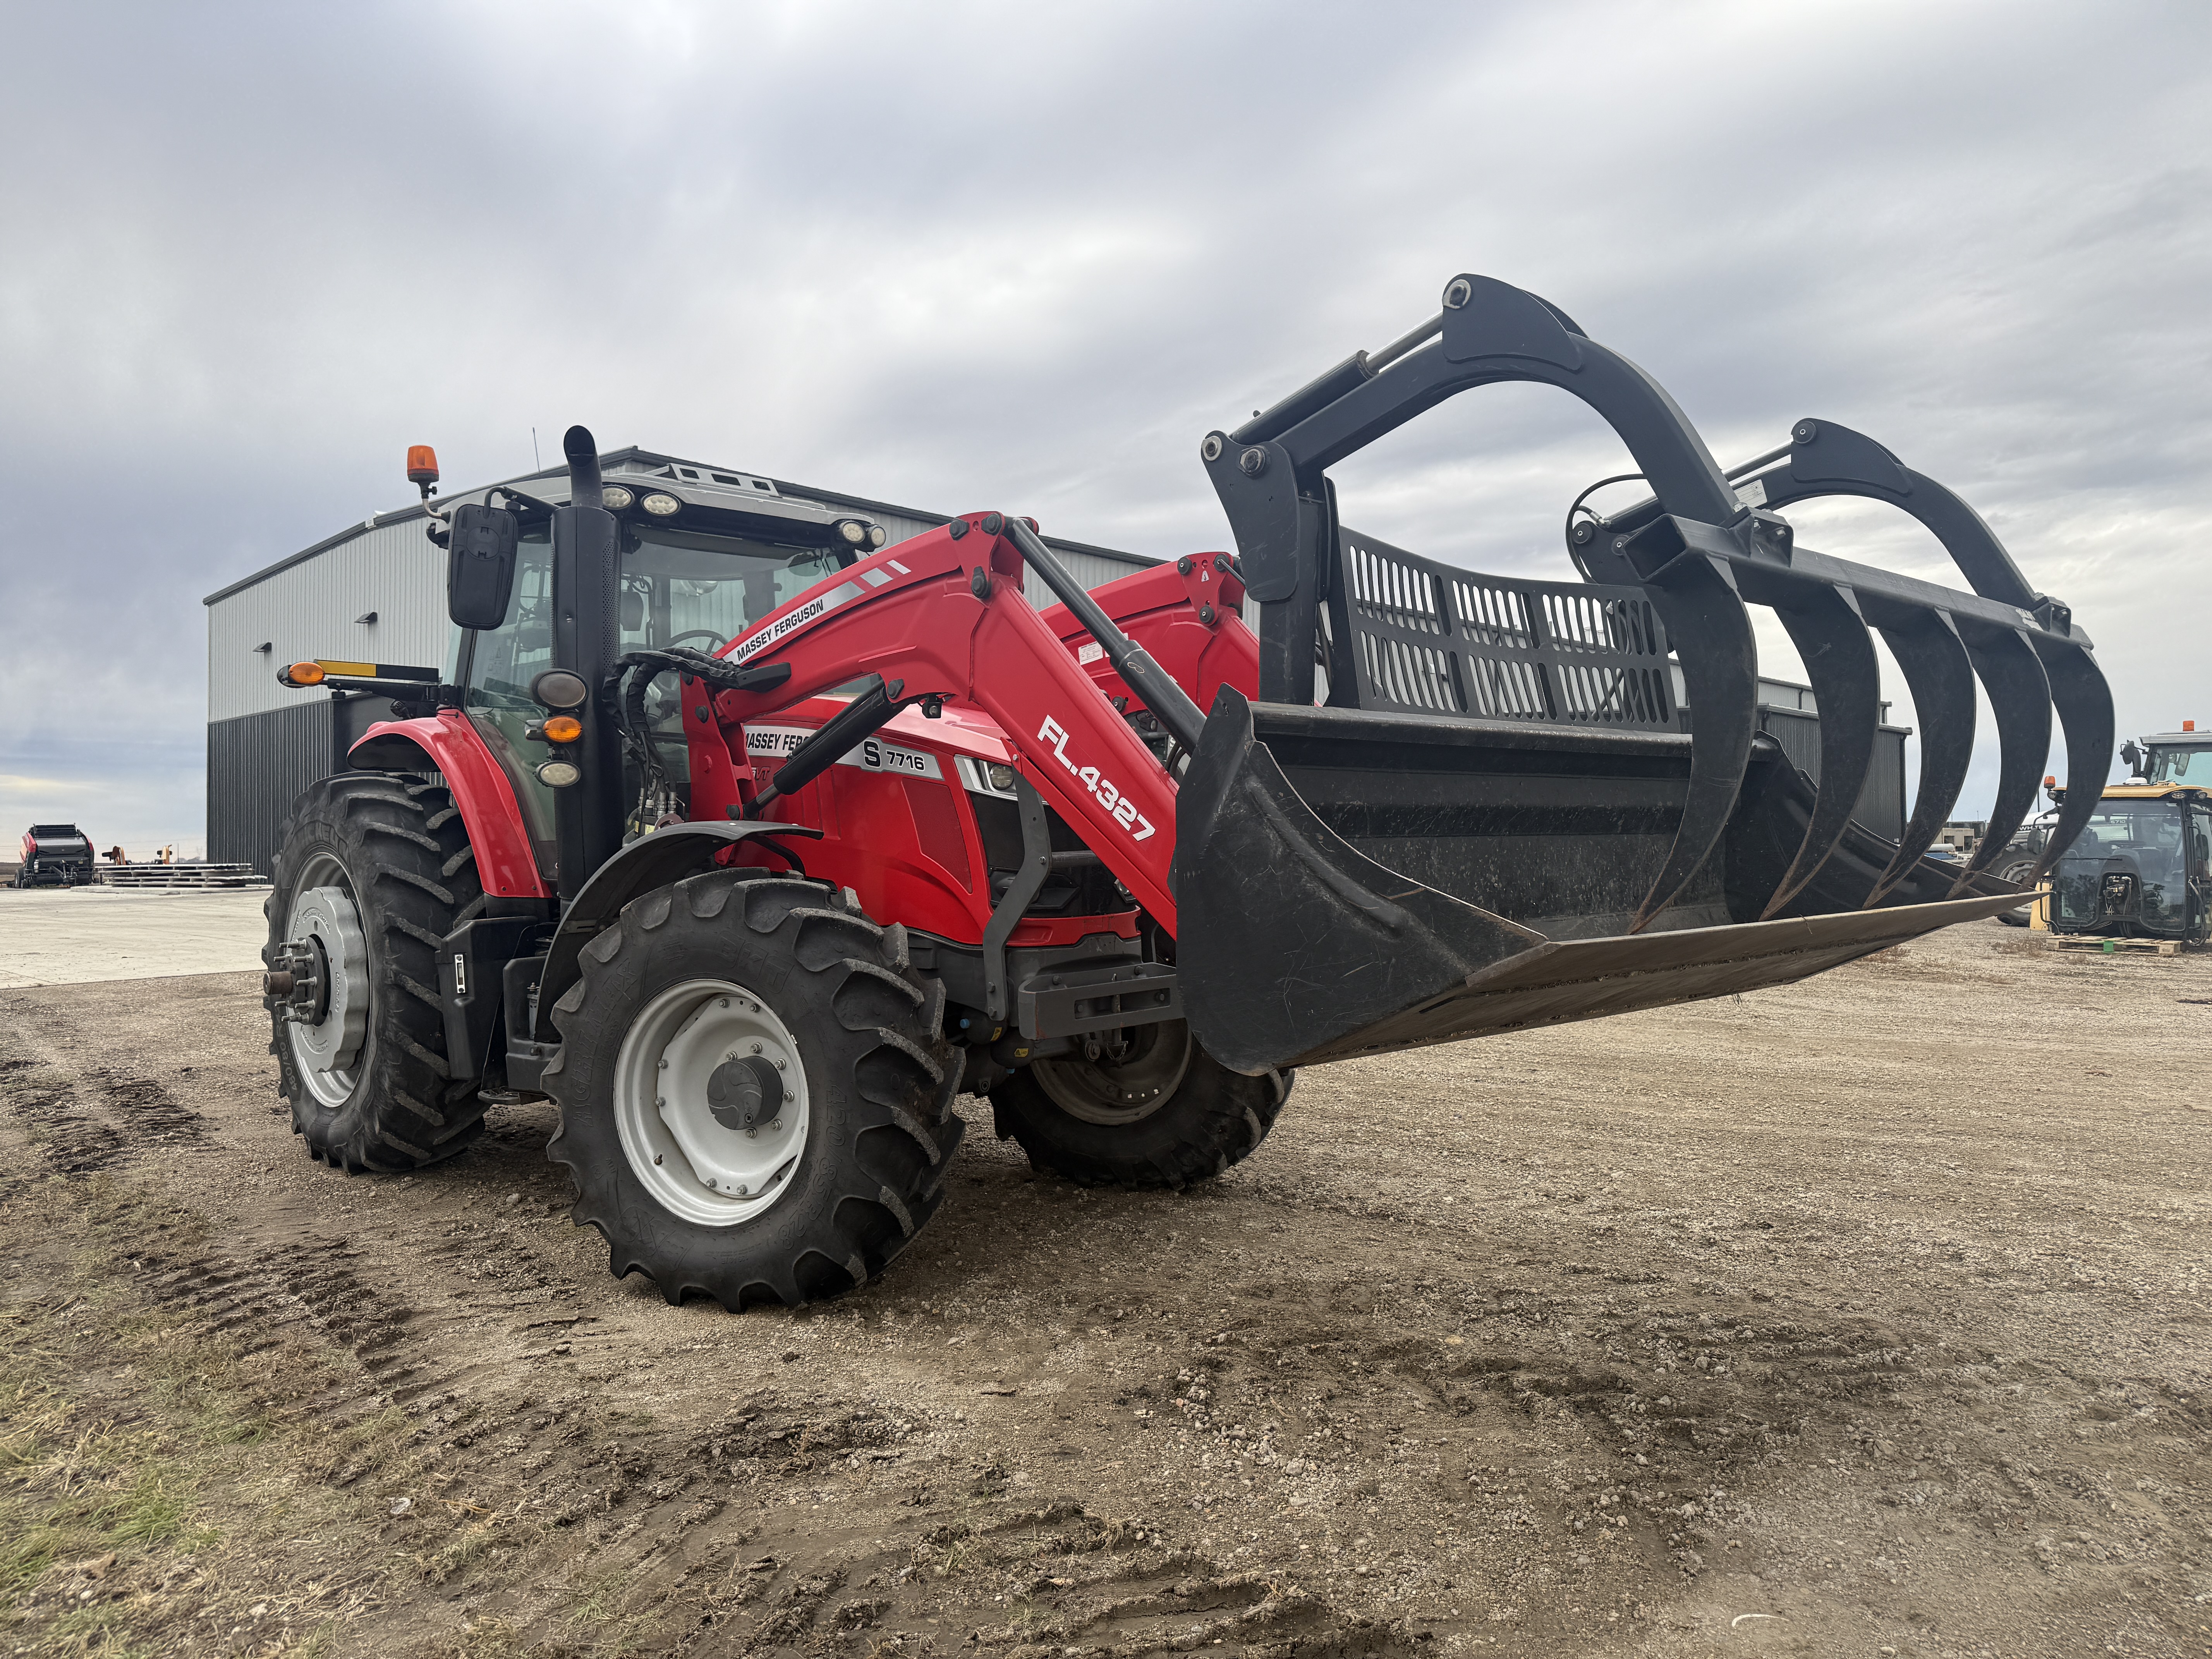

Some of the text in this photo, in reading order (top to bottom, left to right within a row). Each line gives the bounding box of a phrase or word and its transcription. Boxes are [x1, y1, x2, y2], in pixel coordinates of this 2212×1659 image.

[737, 599, 824, 661] MASSEY FERGUSON
[782, 735, 810, 750] FER
[863, 740, 925, 771] S 7716
[1037, 714, 1156, 842] FL.4327
[280, 1041, 297, 1091] 480/80
